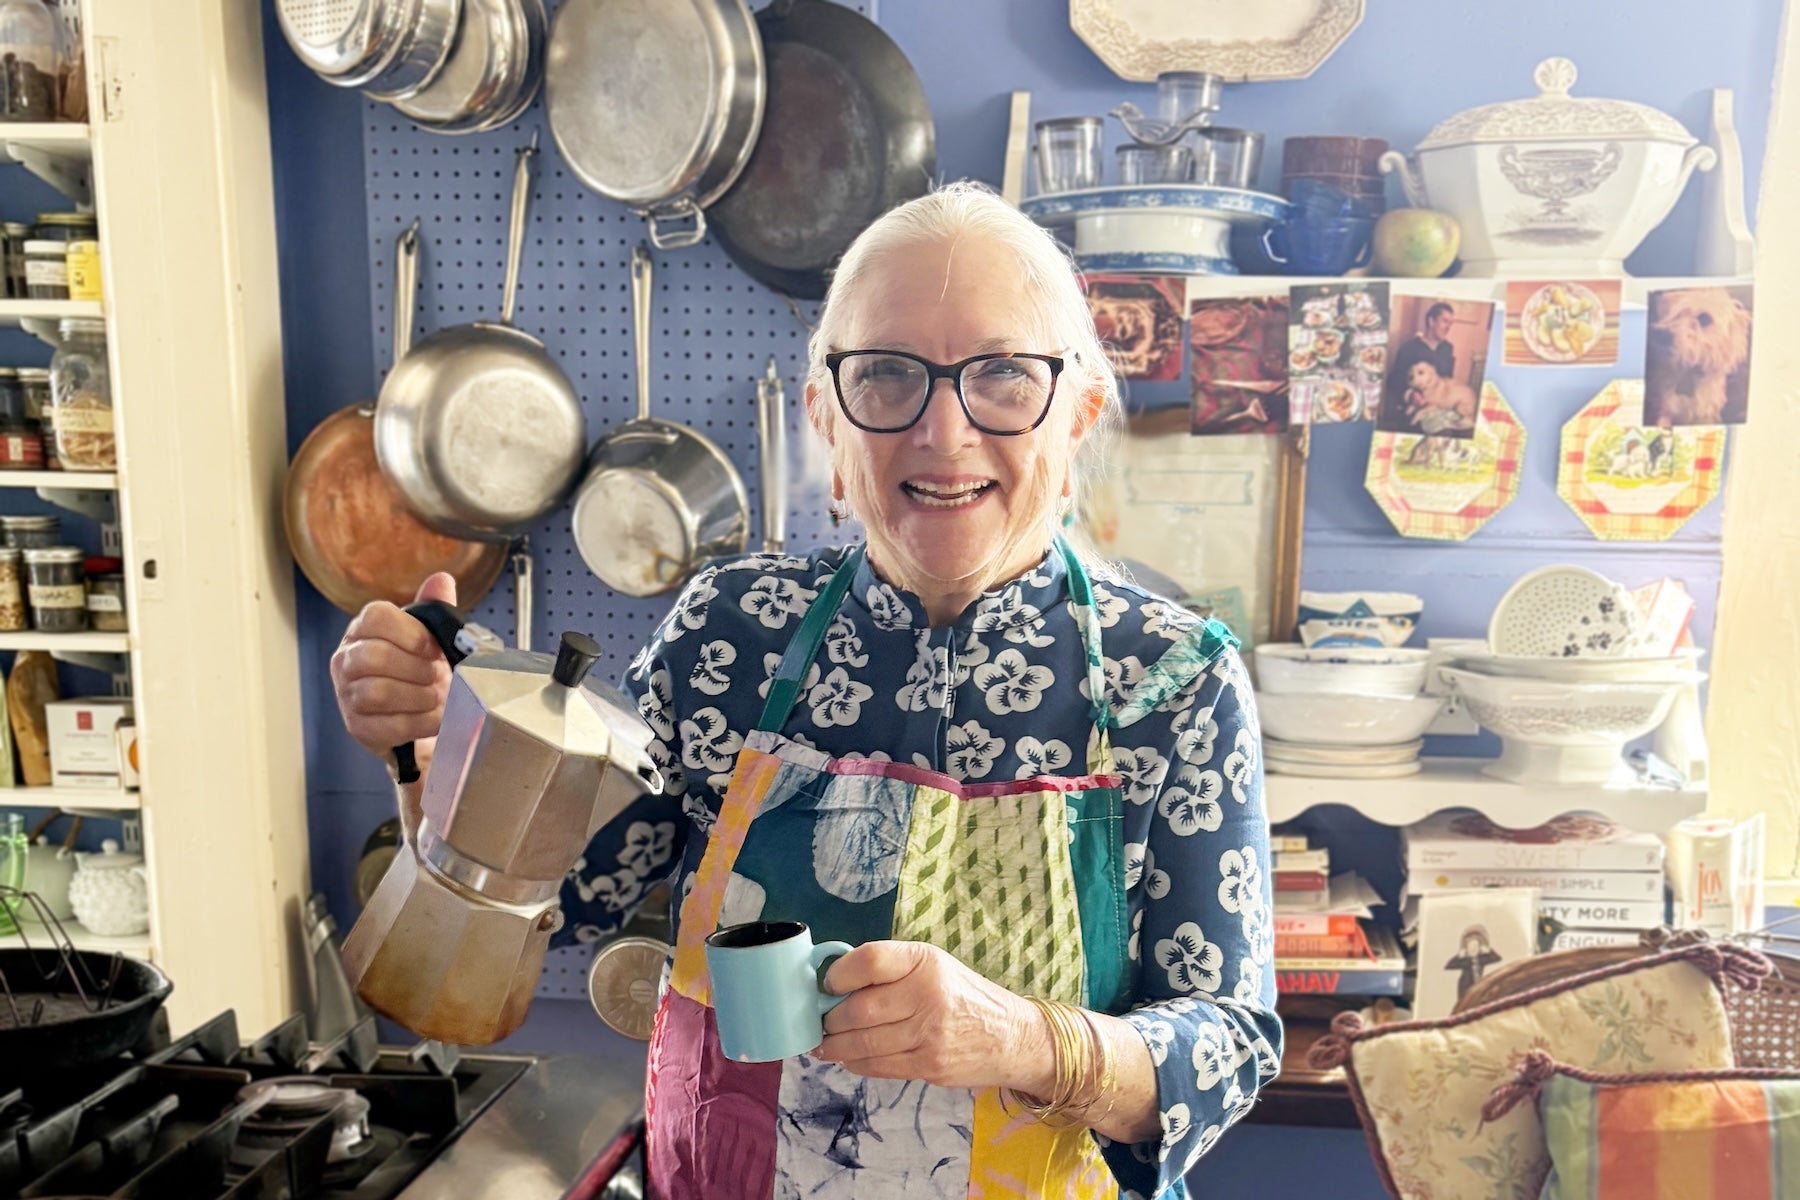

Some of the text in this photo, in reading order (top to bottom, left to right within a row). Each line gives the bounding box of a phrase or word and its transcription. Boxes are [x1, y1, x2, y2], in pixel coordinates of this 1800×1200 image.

[1495, 847, 1587, 868] SWEET
[1470, 876, 1605, 891] OTTOLENGHI SIMPLE
[1577, 906, 1631, 921] MORE
[1276, 971, 1340, 993] AHAV
